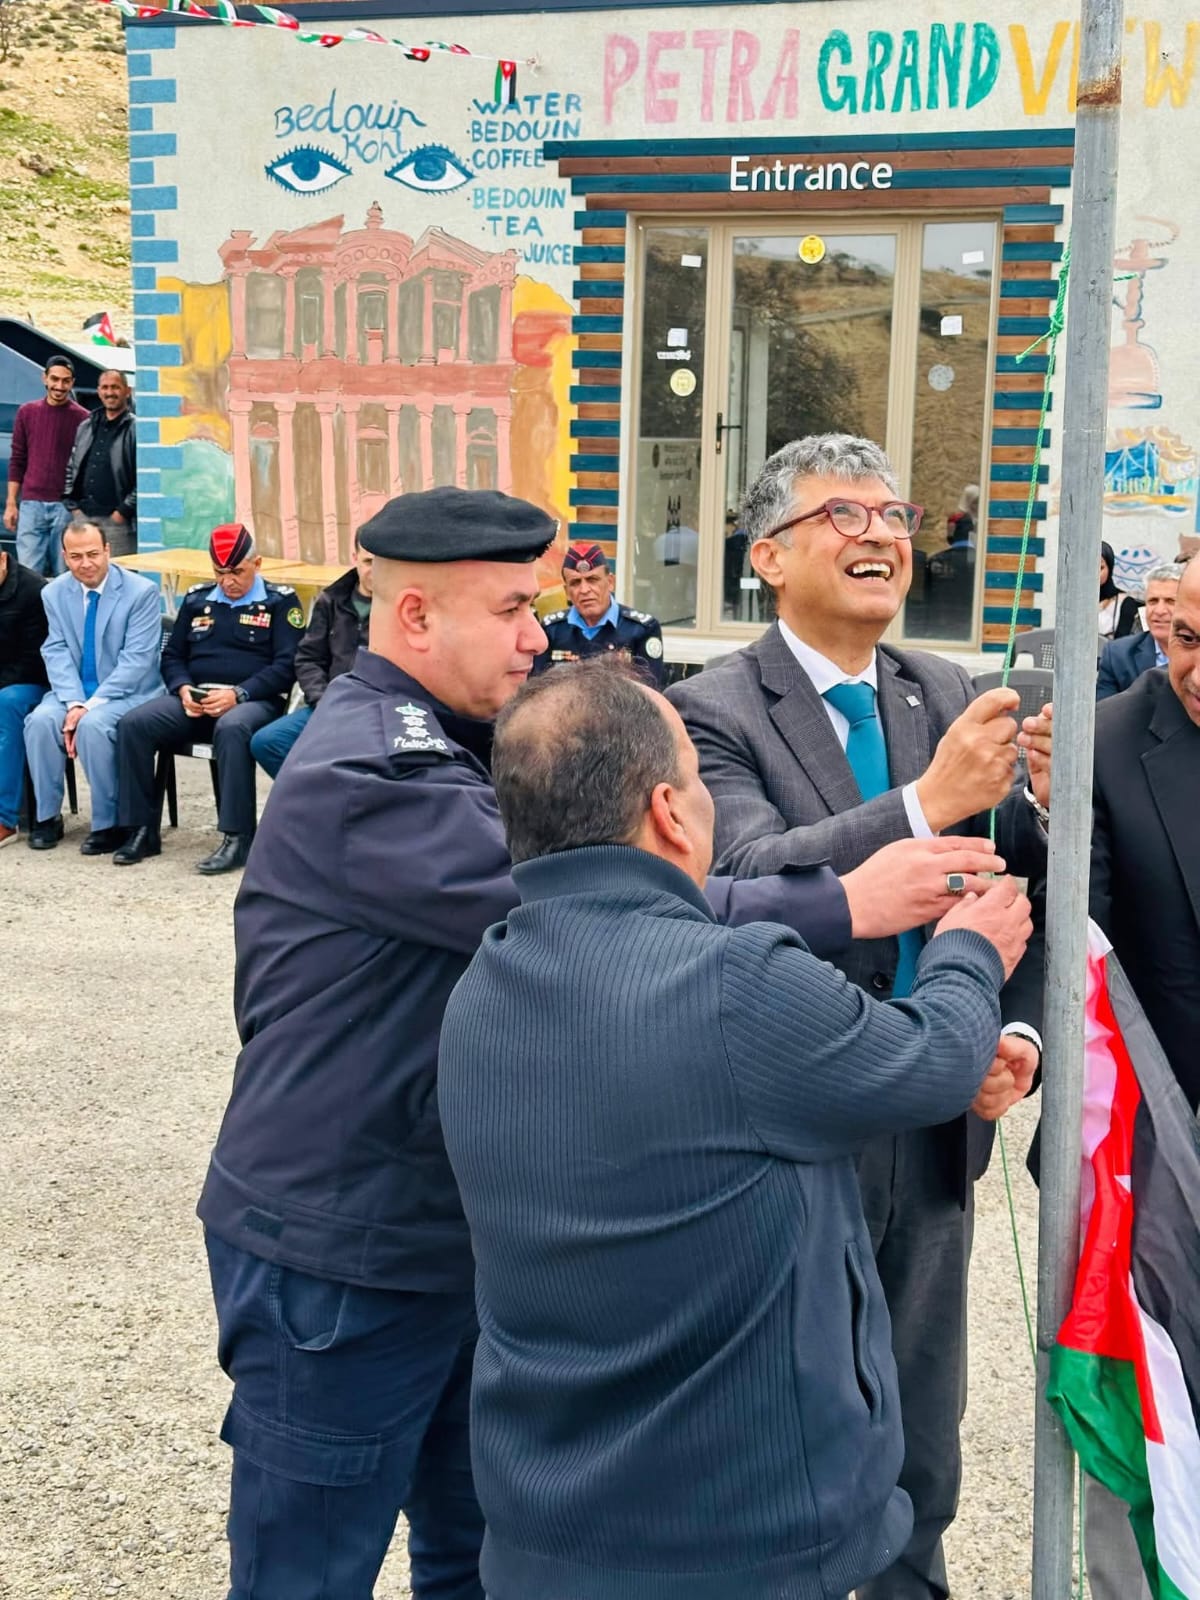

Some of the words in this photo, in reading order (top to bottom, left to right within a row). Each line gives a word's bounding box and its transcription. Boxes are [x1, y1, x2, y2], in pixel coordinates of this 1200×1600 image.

[603, 28, 801, 125] PETRA
[817, 22, 1001, 115] GRAND
[1008, 18, 1200, 116] VIW
[274, 87, 427, 138] Bedouin
[472, 92, 582, 116] WATER
[471, 118, 582, 142] BEDOUIN
[341, 129, 407, 164] Kohl
[472, 148, 546, 169] COFFEE
[730, 155, 893, 192] Entrance
[472, 187, 566, 209] BEDOUIN
[486, 215, 544, 237] TEA
[522, 243, 572, 265] JUICE
